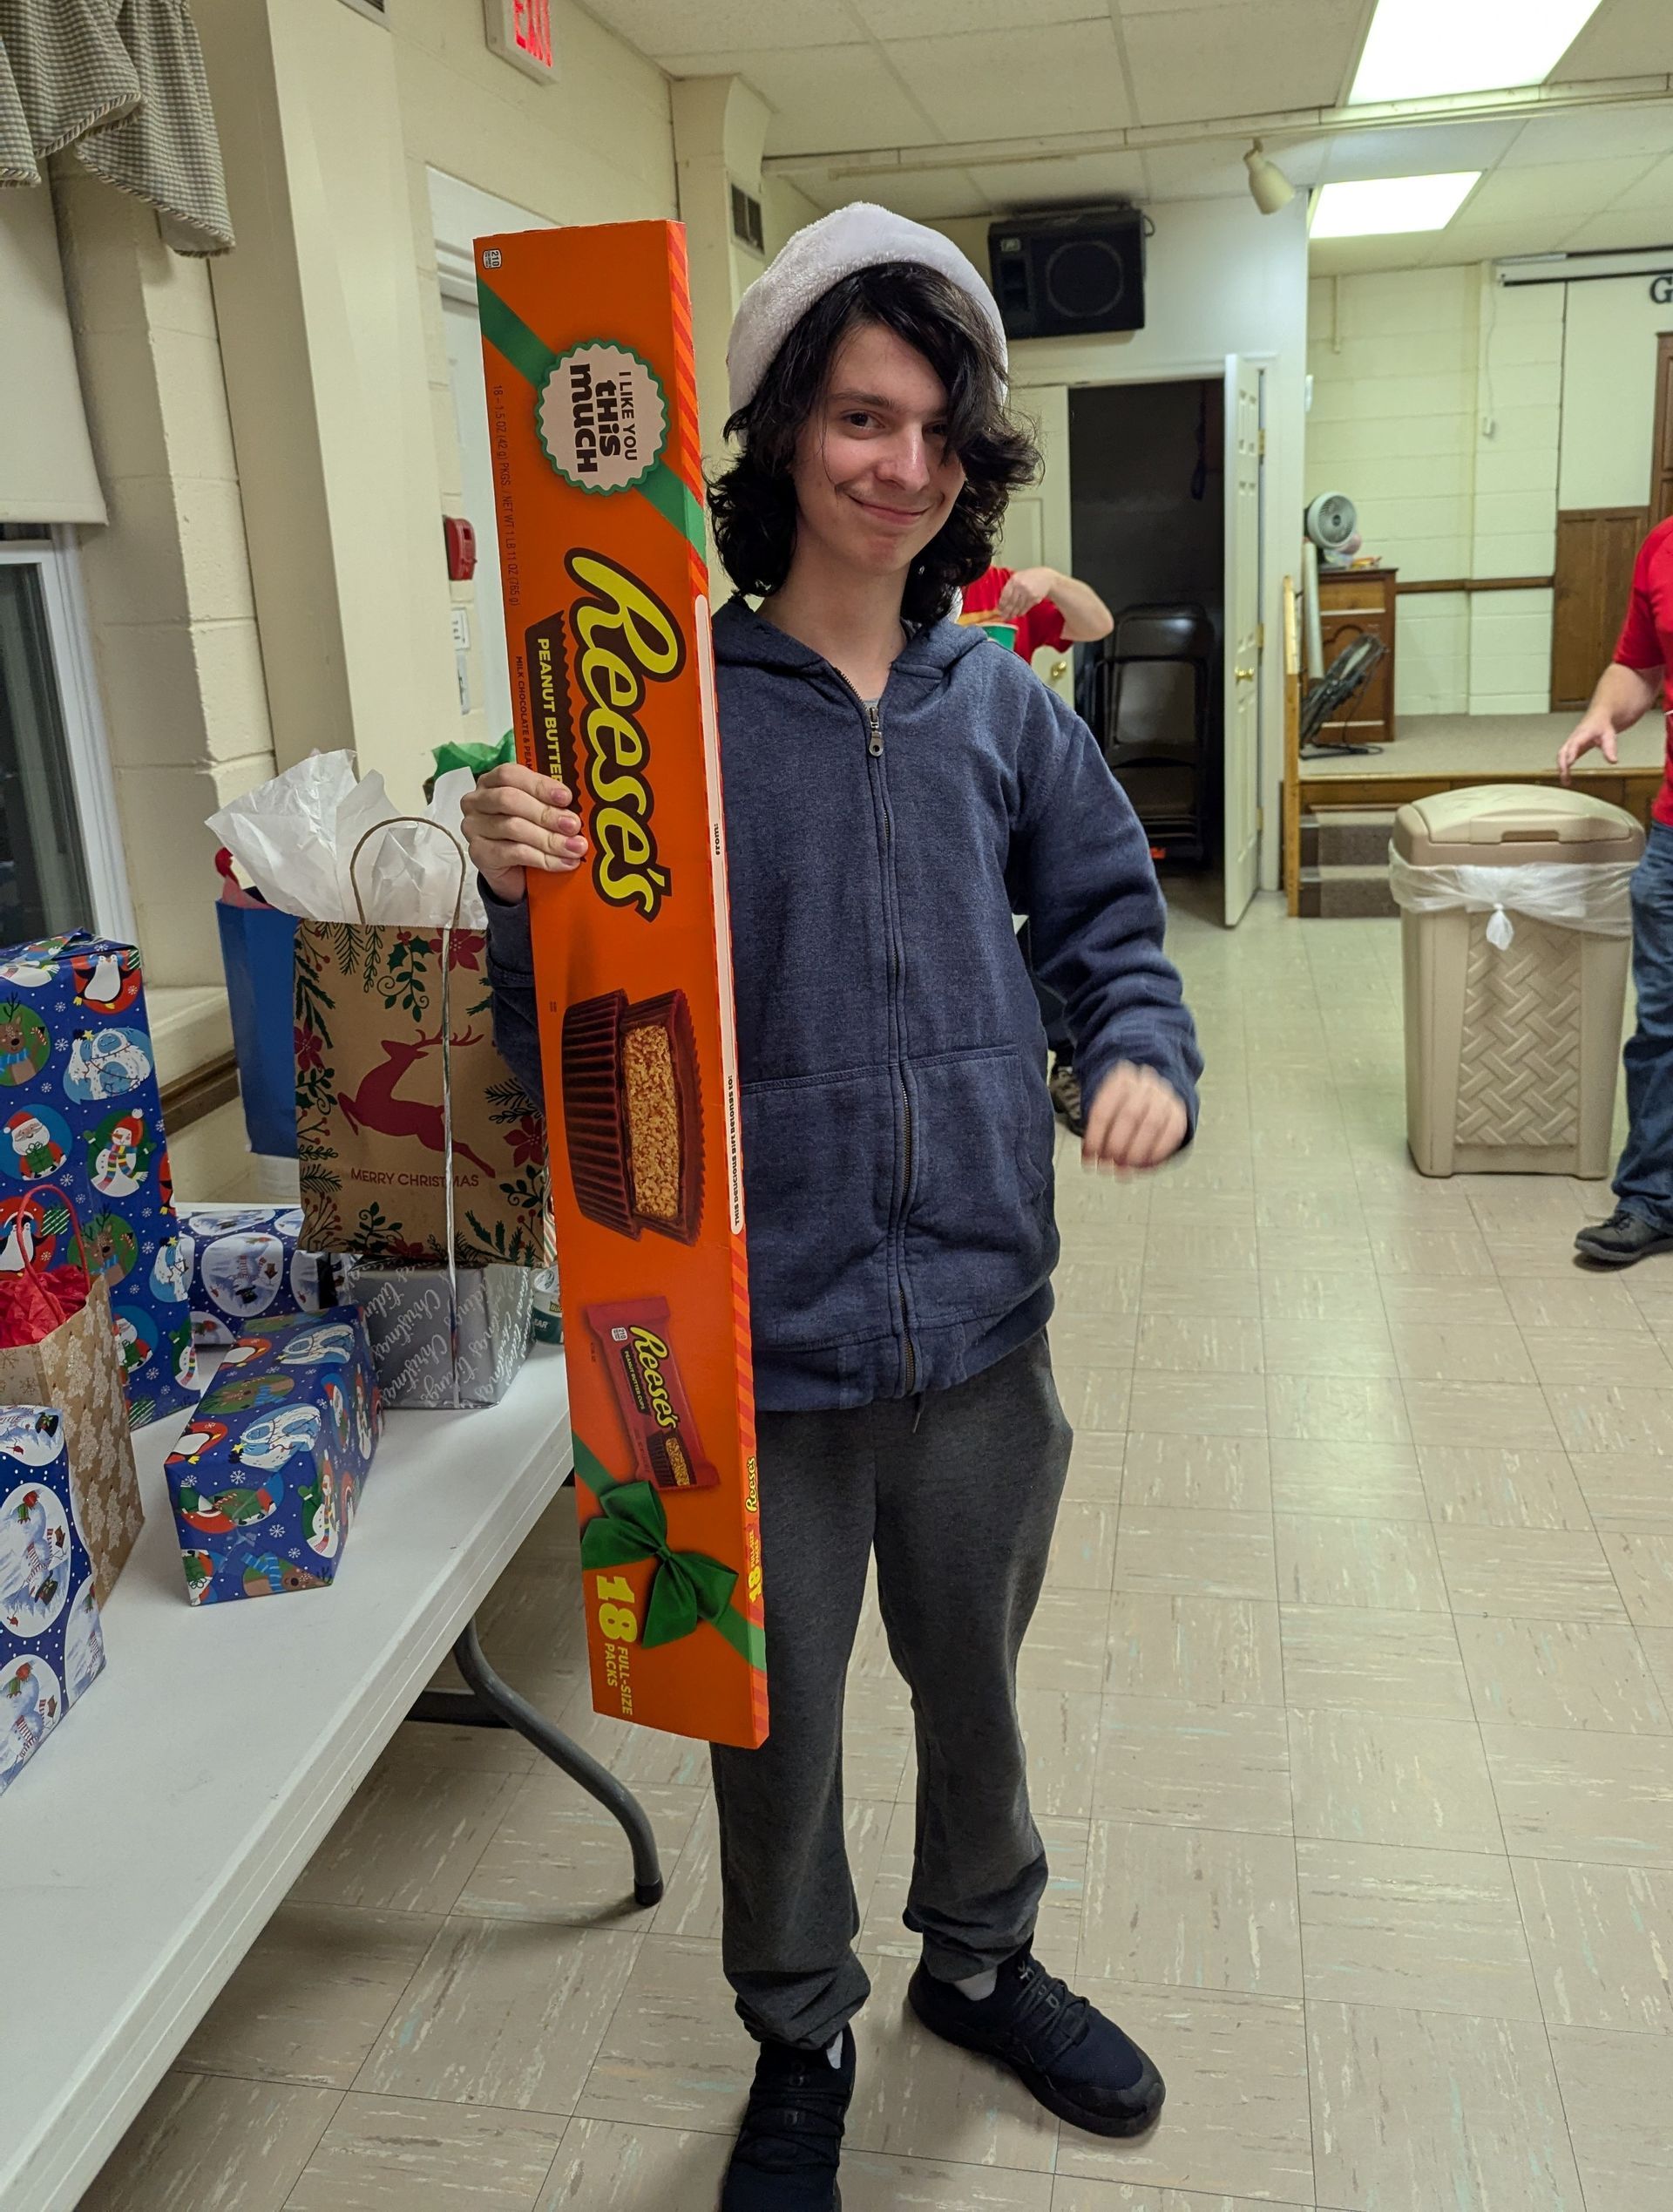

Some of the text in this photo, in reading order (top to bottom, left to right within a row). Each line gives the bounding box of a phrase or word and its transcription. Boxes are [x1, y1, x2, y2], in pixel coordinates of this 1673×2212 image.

[491, 250, 500, 267] 210
[493, 384, 503, 396] 18
[620, 378, 634, 420] LIKE
[622, 426, 638, 461] YOU
[502, 496, 513, 513] NET
[504, 515, 515, 530] WT
[506, 539, 517, 550] LB
[508, 562, 519, 574] OZ
[516, 655, 525, 678] MILK
[538, 638, 556, 713] PEANUT
[518, 680, 530, 736] CHOCOLATE
[570, 553, 680, 917] Reese's
[524, 745, 533, 772] PEAN
[350, 1168, 395, 1185] MERRY
[372, 1289, 441, 1360] Christmas
[382, 1334, 448, 1405] Christmas
[624, 1350, 646, 1411] PEANUT BUTTER CUPS
[629, 1326, 678, 1428] Reese's
[745, 1456, 757, 1513] Reese's
[748, 1566, 762, 1603] 18
[596, 1575, 638, 1643] 18
[604, 1642, 618, 1687] PACKS
[618, 1646, 633, 1716] FULL-SIZE
